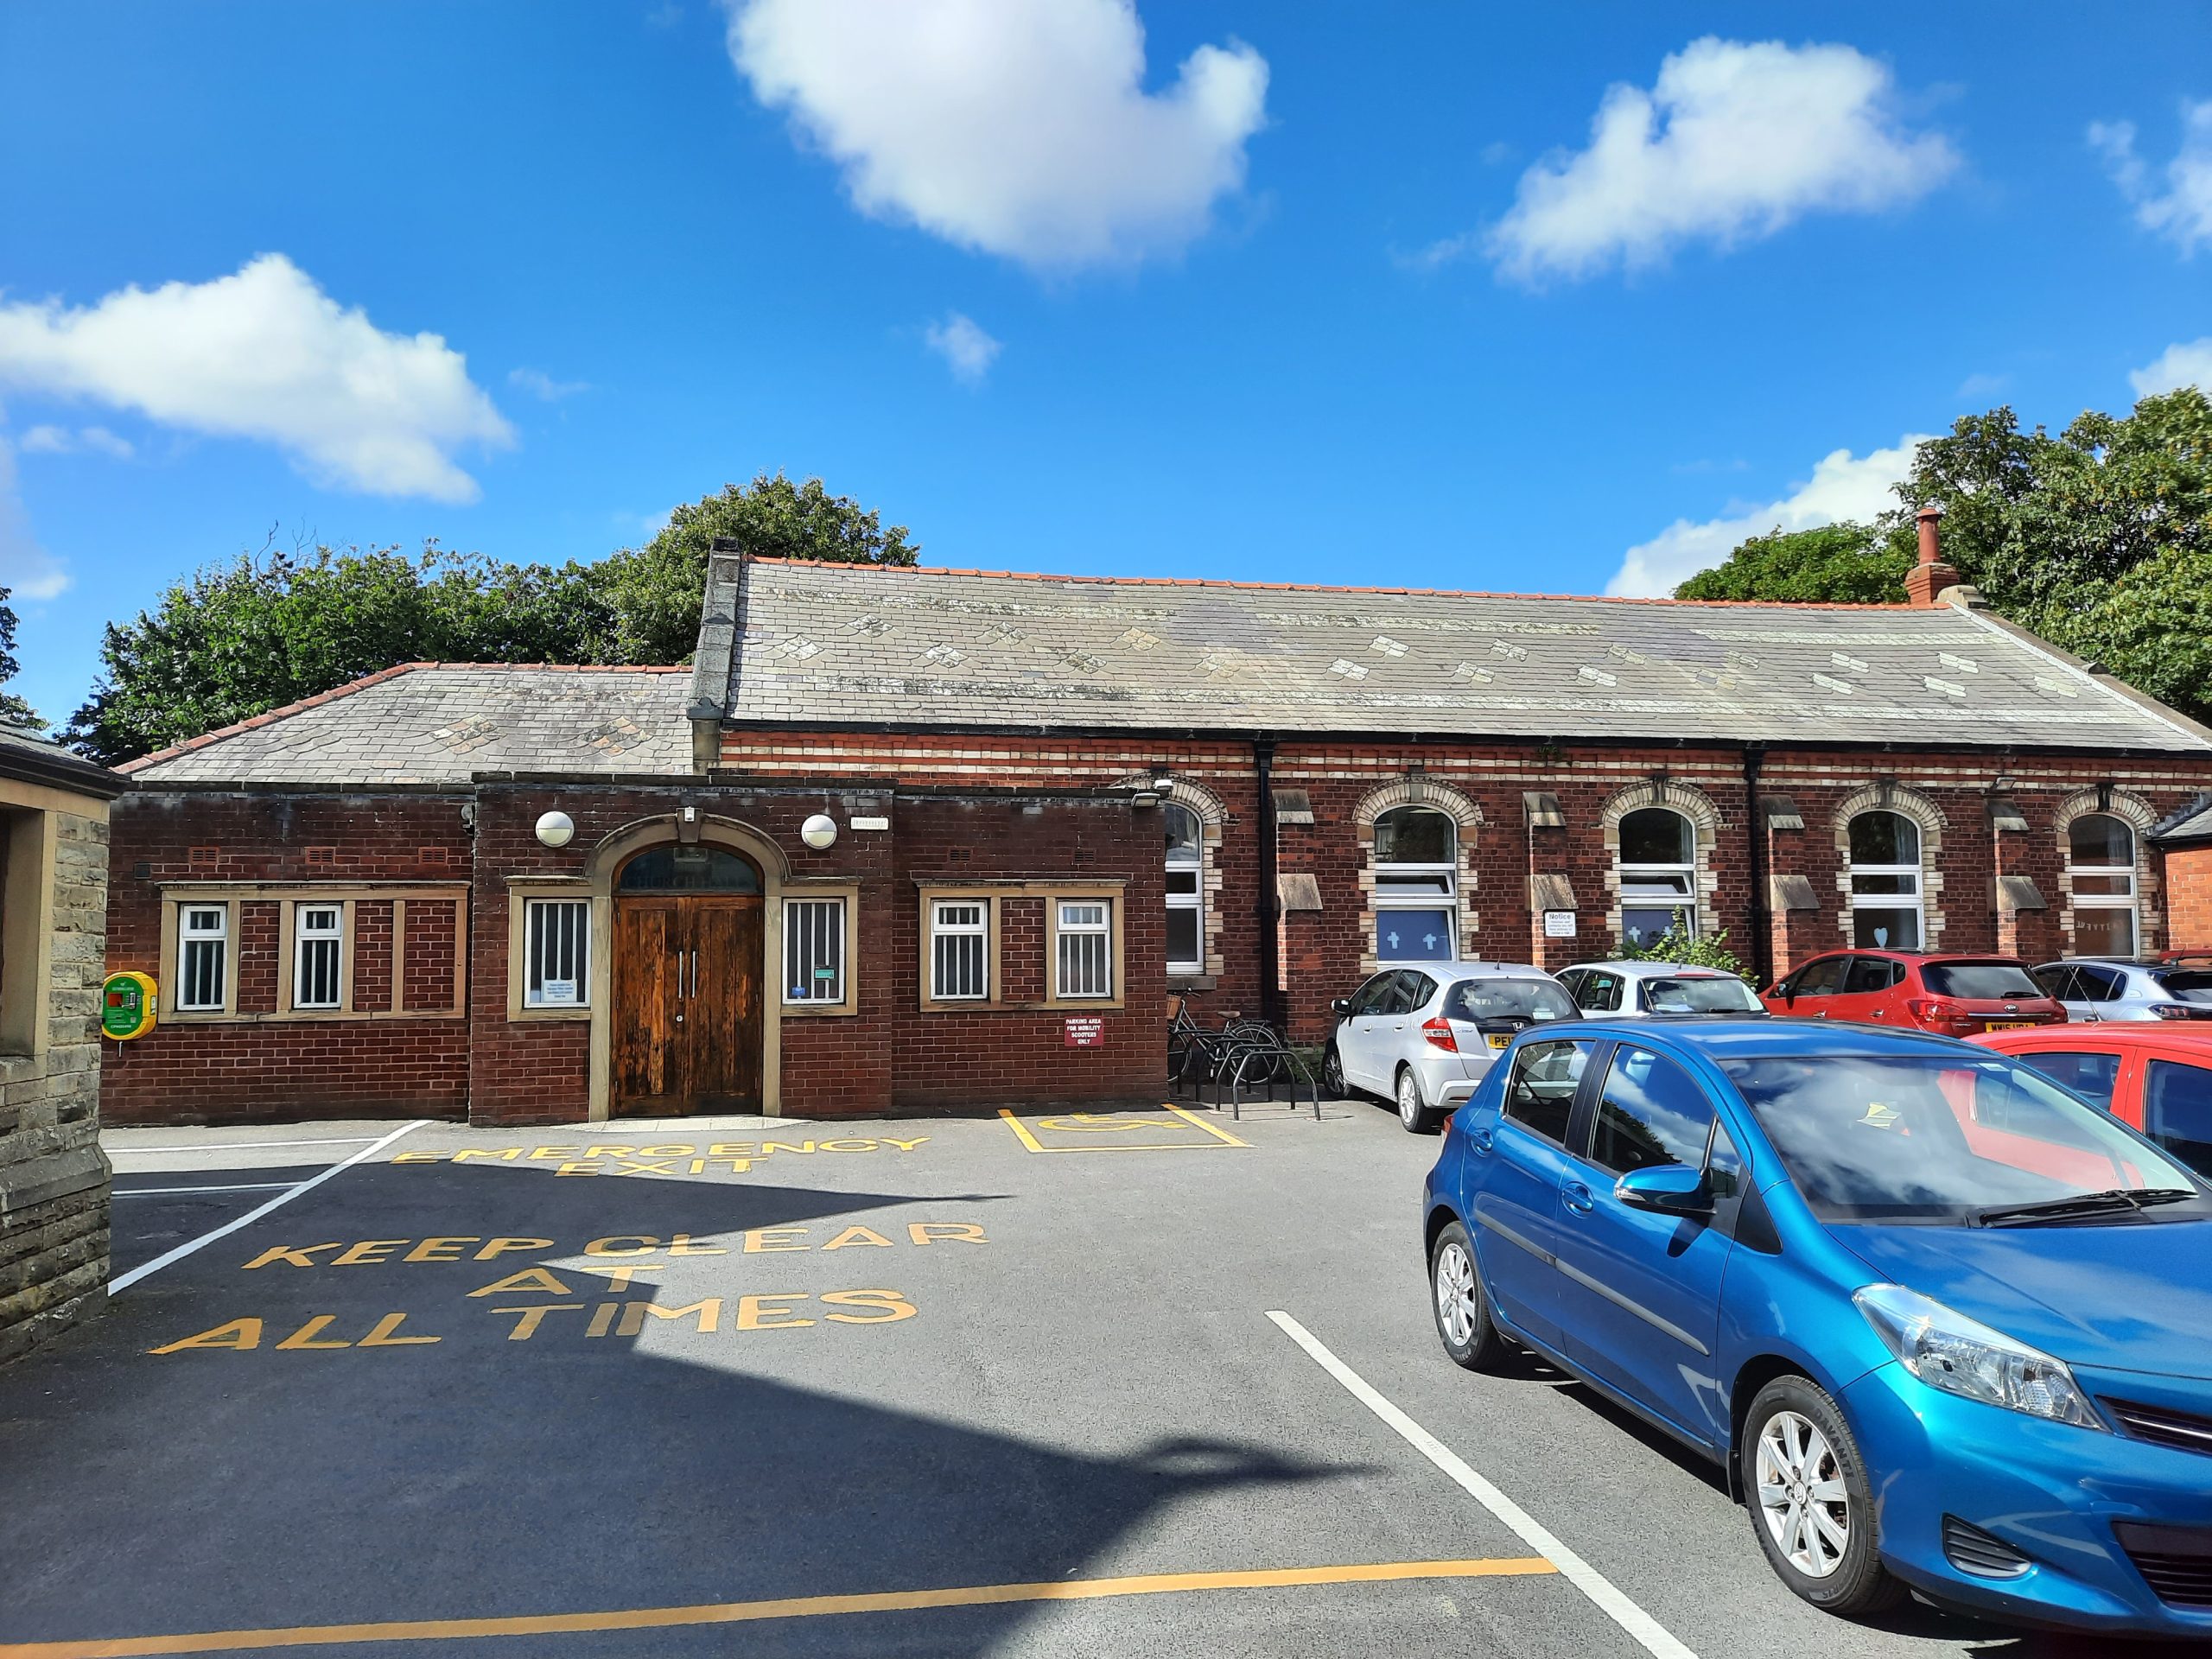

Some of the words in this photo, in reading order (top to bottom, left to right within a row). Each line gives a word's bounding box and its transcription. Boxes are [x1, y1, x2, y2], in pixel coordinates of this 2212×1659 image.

[391, 1135, 932, 1165] EMERGENCY
[554, 1156, 769, 1177] EXIT
[242, 1237, 556, 1269] KEEP
[584, 1222, 991, 1259] CLEAR
[467, 1264, 664, 1298] AT
[147, 1313, 442, 1354] ALL
[489, 1289, 918, 1339] TIMES
